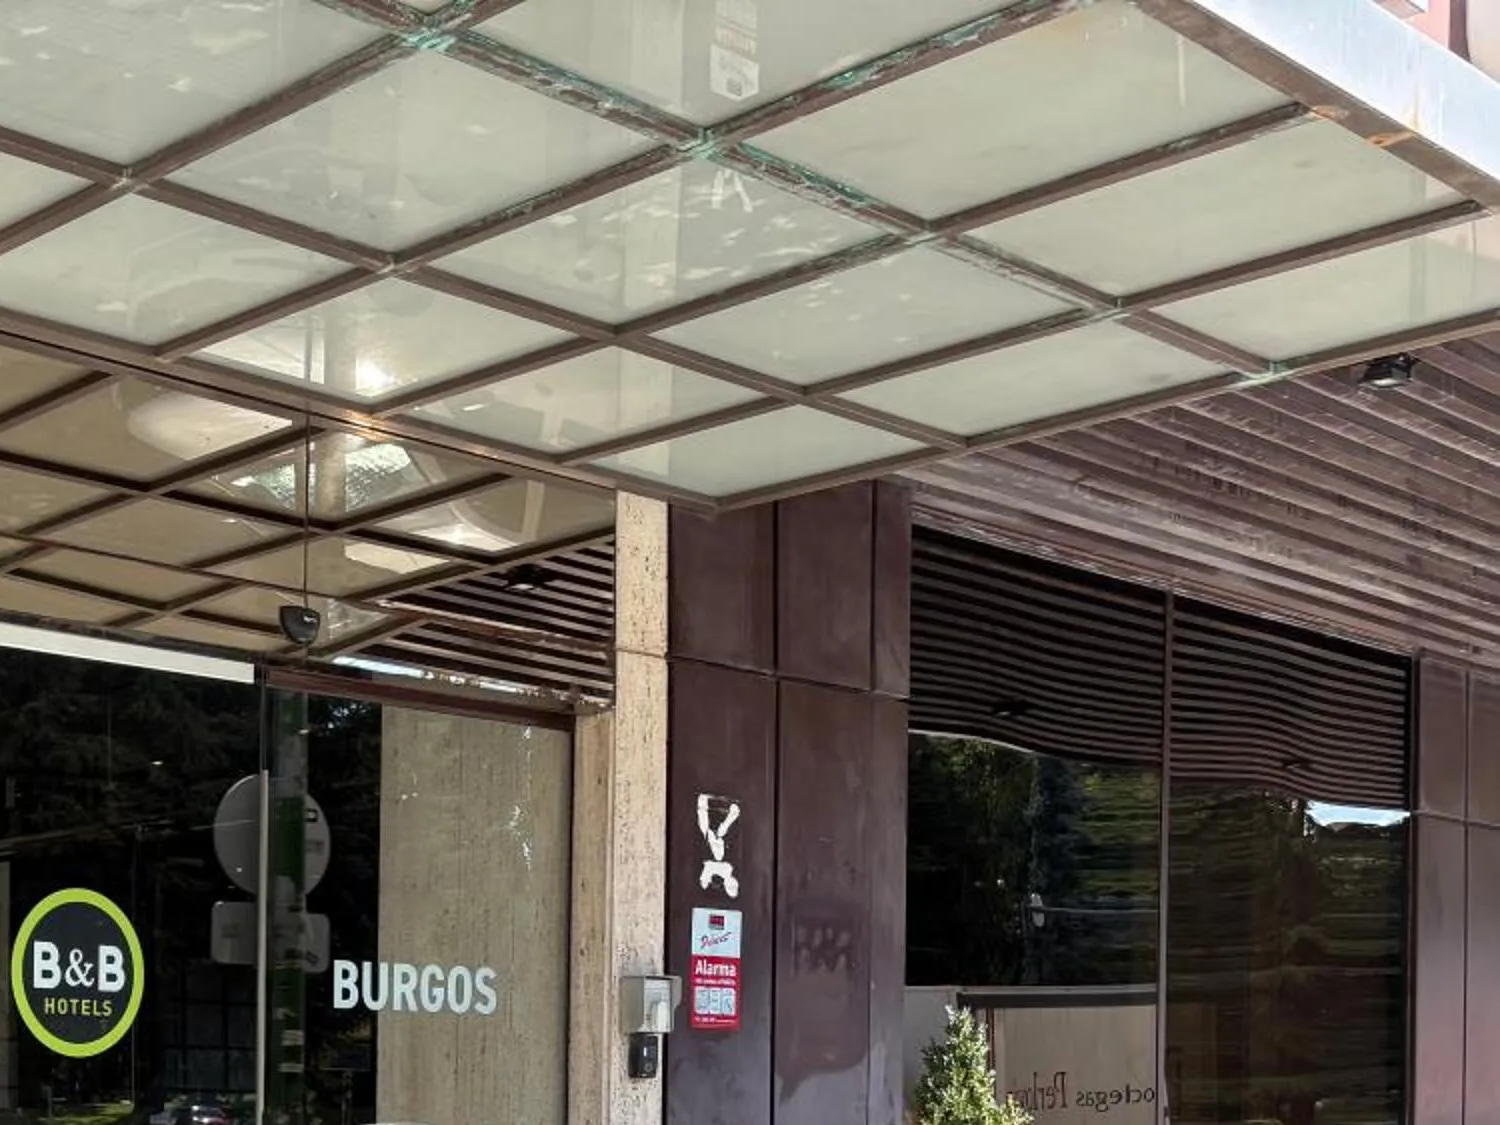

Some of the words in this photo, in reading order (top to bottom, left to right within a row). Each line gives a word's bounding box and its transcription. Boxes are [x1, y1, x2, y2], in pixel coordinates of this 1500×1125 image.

[33, 941, 126, 992] B&B
[695, 959, 737, 977] Alarma
[332, 959, 498, 1015] BURGOS
[43, 996, 113, 1017] HOTELS
